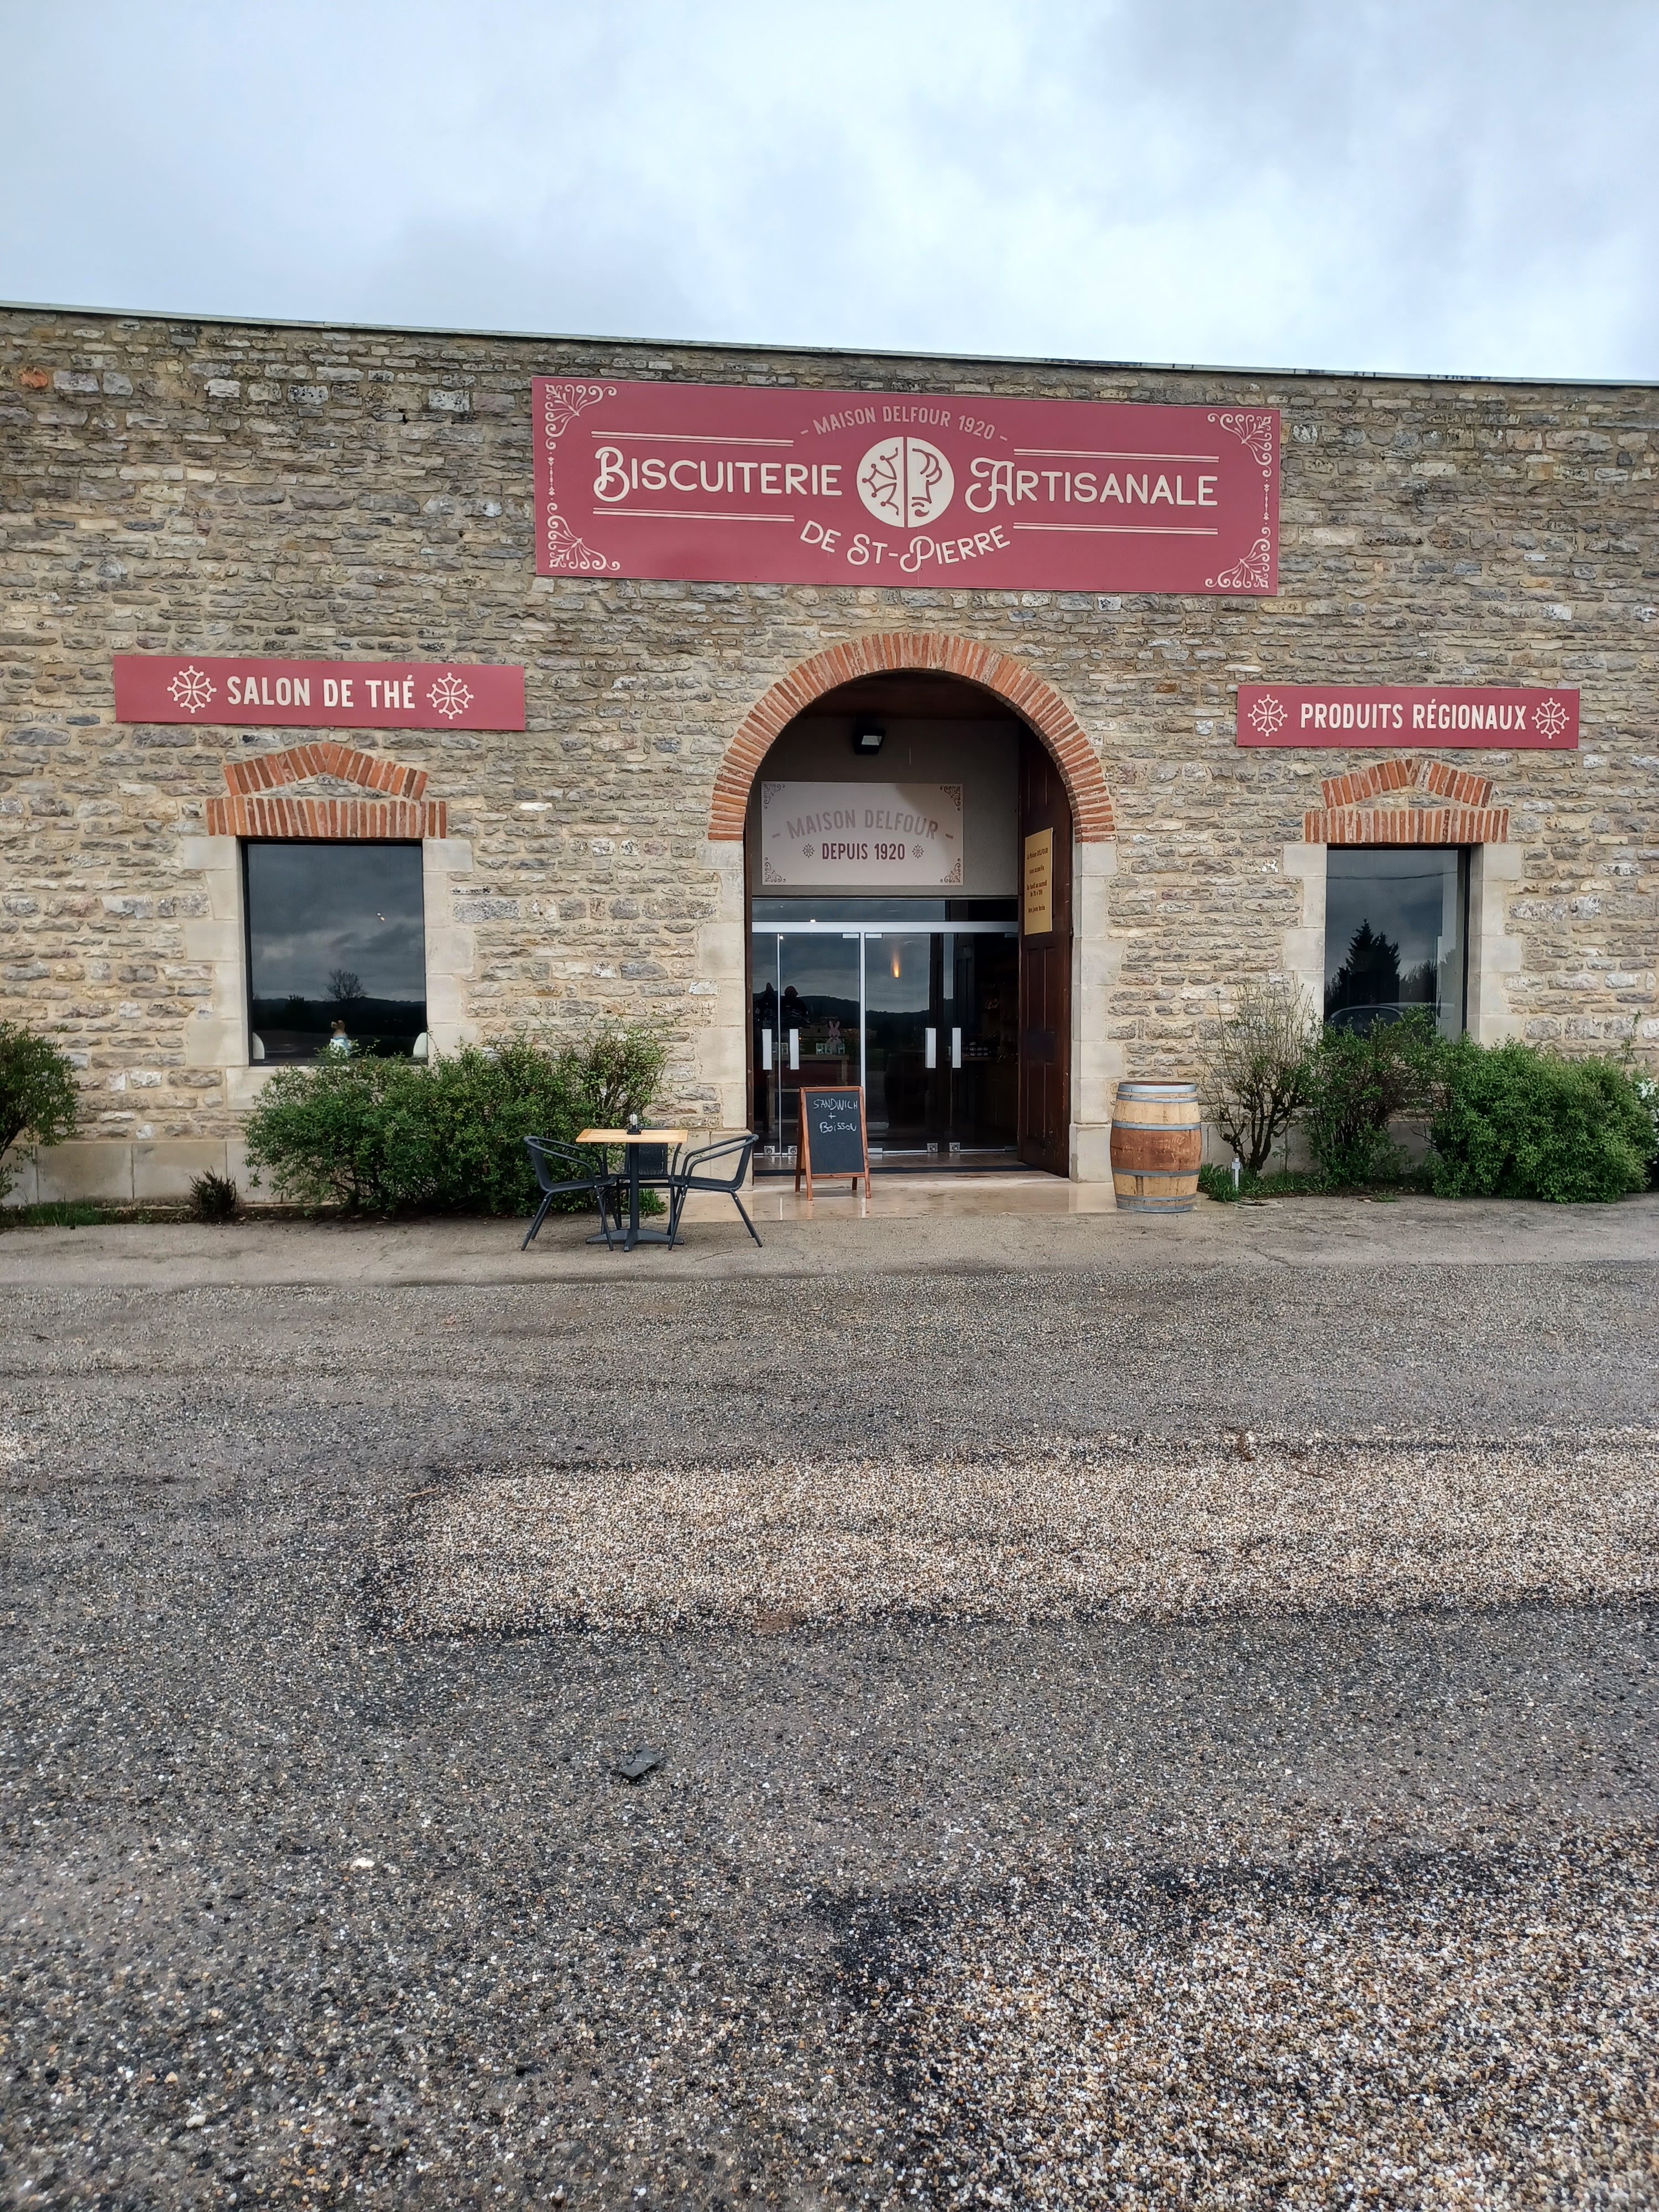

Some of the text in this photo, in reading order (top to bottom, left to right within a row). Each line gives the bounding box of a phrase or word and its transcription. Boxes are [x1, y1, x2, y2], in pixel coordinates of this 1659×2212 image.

[813, 405, 996, 440] MAISON DELFOUR 1920
[593, 446, 843, 502] BISCUITERIE
[964, 457, 1219, 514] ARTISANALE
[800, 520, 1011, 573] DE ST-PIERRE
[227, 675, 416, 709] SALON DE THÉ
[1301, 698, 1527, 730] PRODUITS RÉGIONAUX
[786, 809, 938, 840] MAISON DELFOUR
[822, 843, 905, 860] DEPUIS 1920
[813, 1098, 858, 1110] SANDWICH
